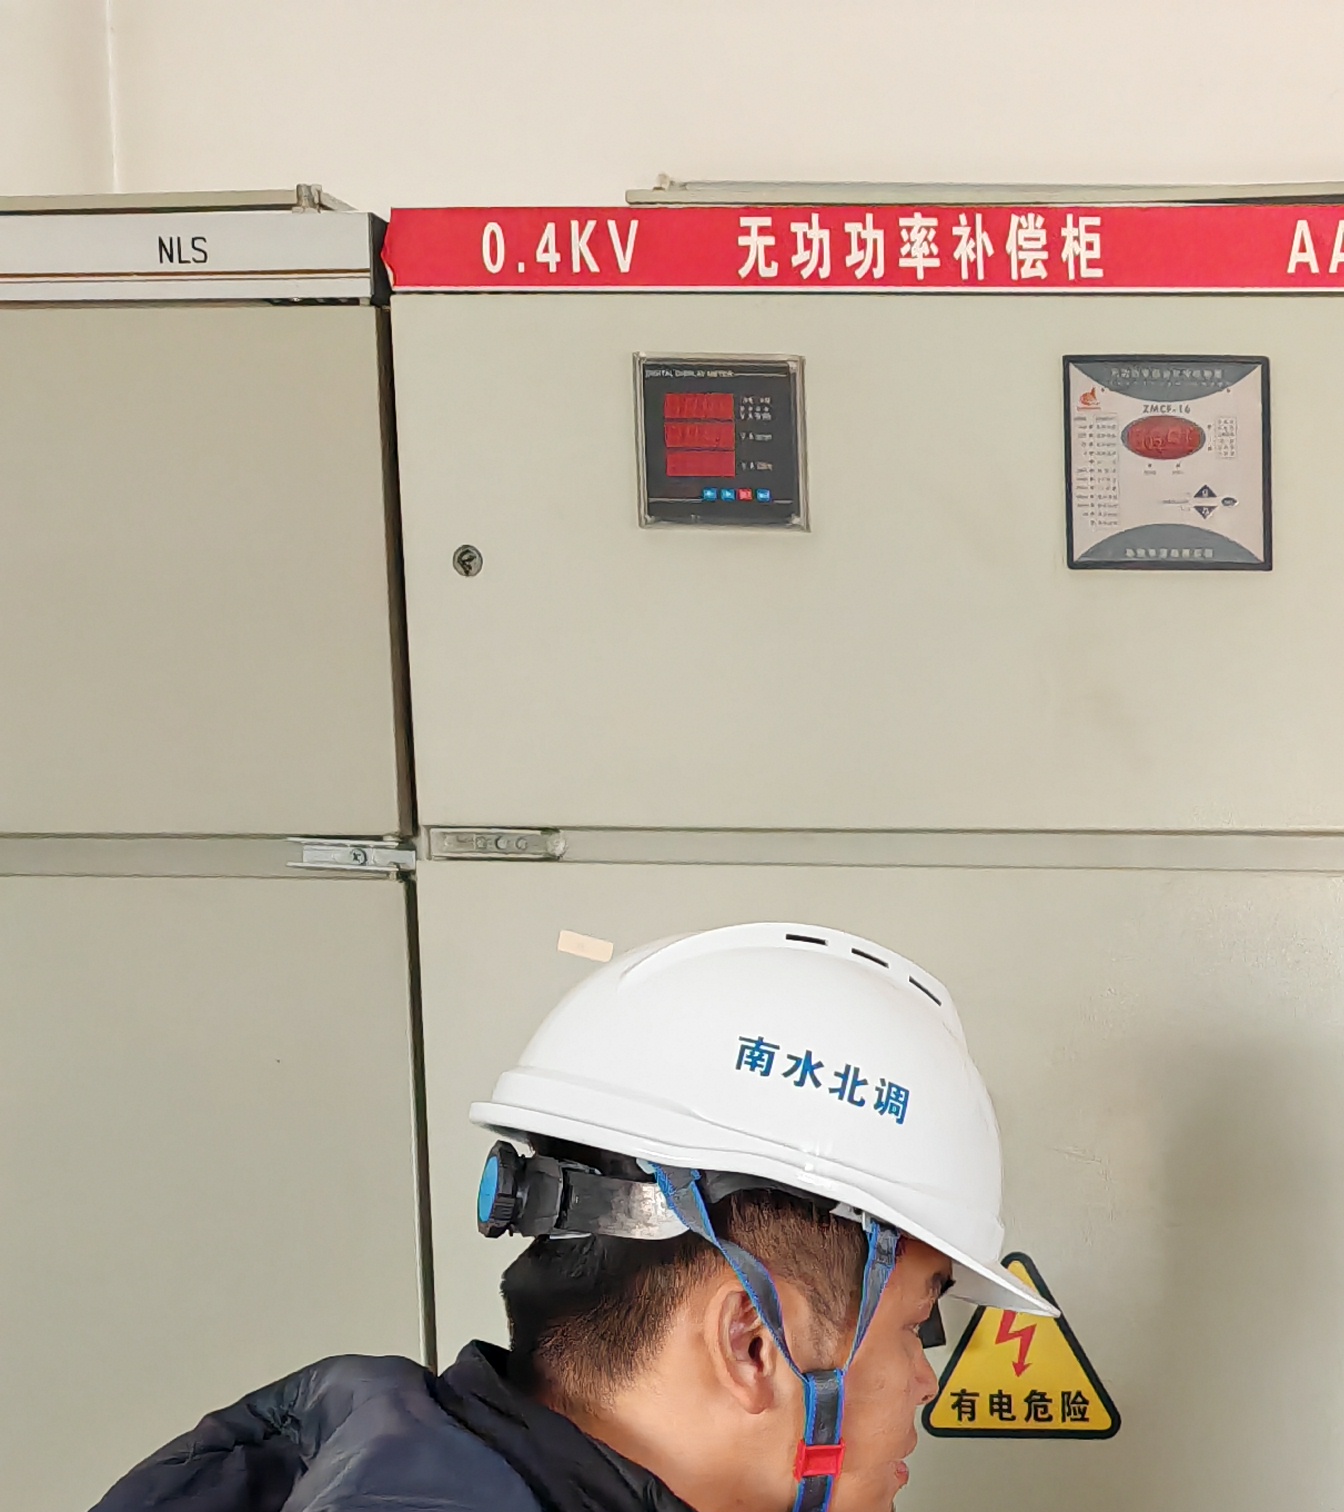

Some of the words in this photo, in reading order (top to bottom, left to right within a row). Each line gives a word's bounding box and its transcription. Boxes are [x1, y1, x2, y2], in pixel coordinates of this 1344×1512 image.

[158, 236, 208, 264] NLS
[482, 219, 639, 274] 0.4KV
[737, 212, 1104, 281] 无功功率补偿柜
[735, 1036, 910, 1125] 南水北调
[950, 1388, 1090, 1423] 有电危险
